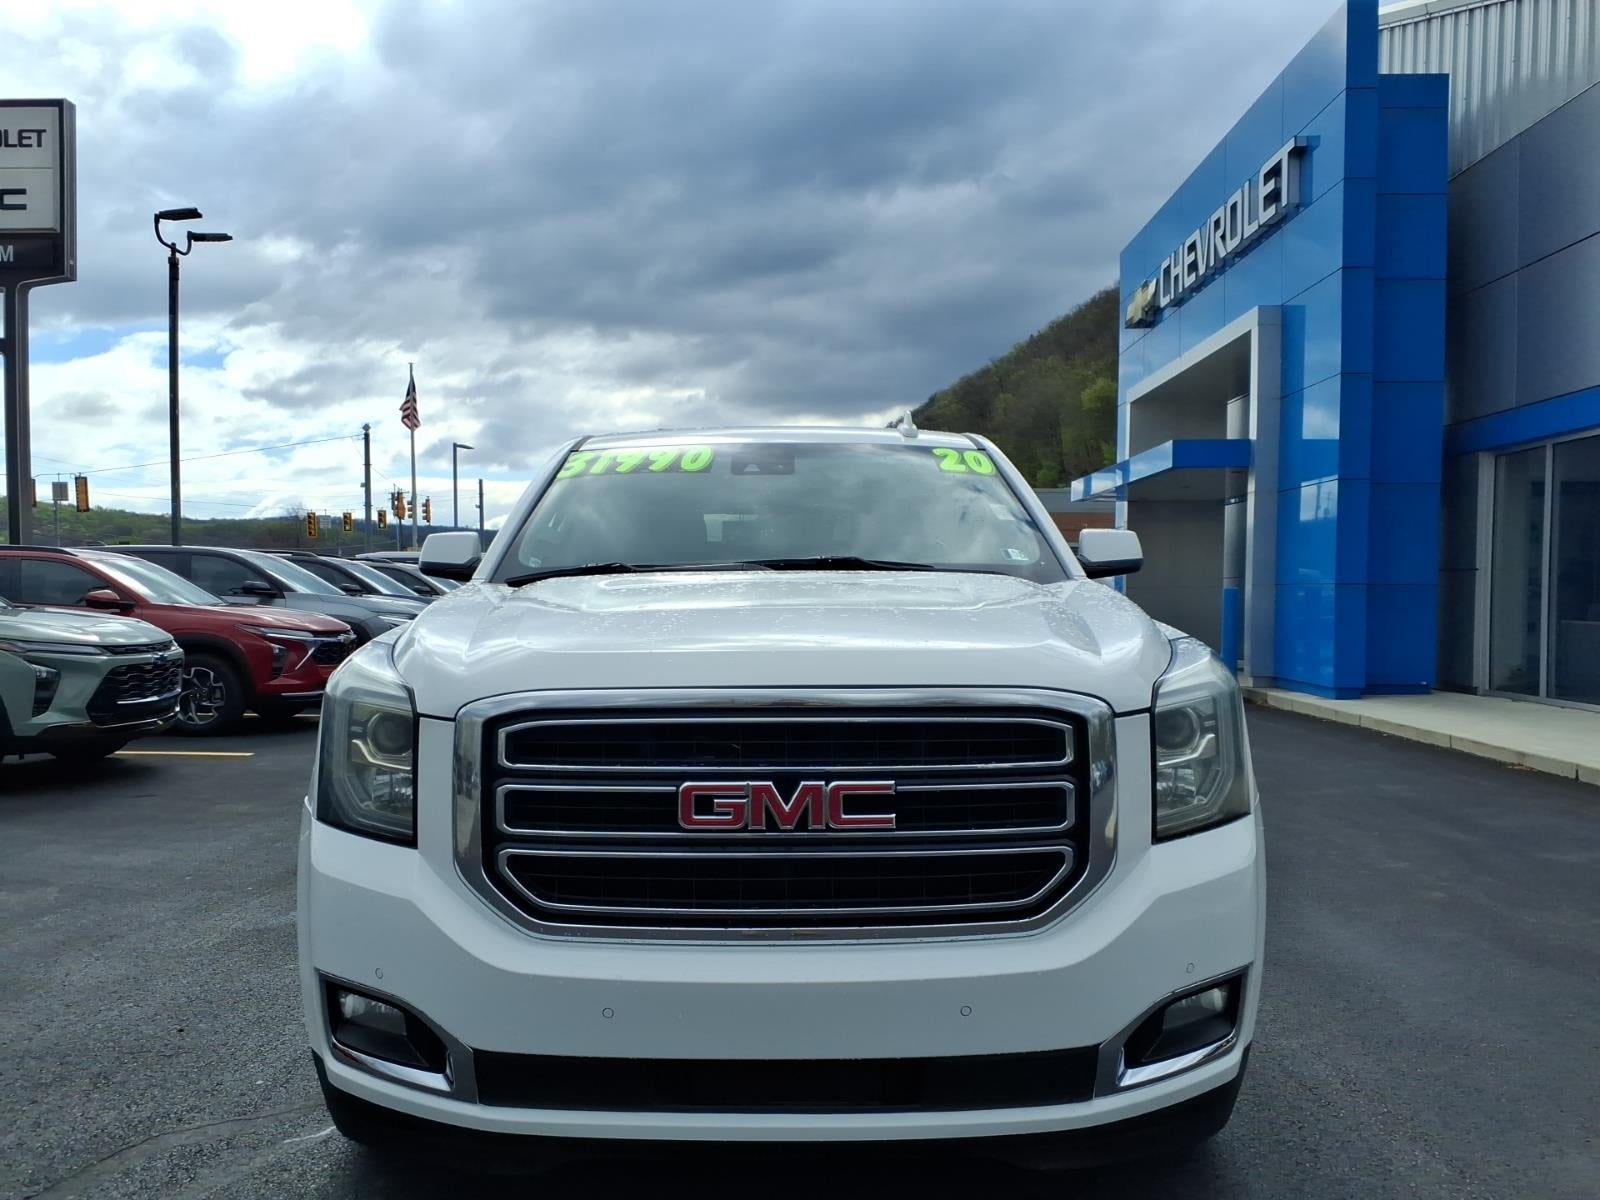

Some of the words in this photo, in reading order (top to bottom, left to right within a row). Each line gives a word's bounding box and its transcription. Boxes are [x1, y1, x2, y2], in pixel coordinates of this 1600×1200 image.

[0, 128, 47, 148] LET
[1159, 134, 1303, 309] CHEVROLET
[556, 446, 714, 481] 31990
[932, 447, 995, 475] 20
[678, 780, 896, 830] GMC
